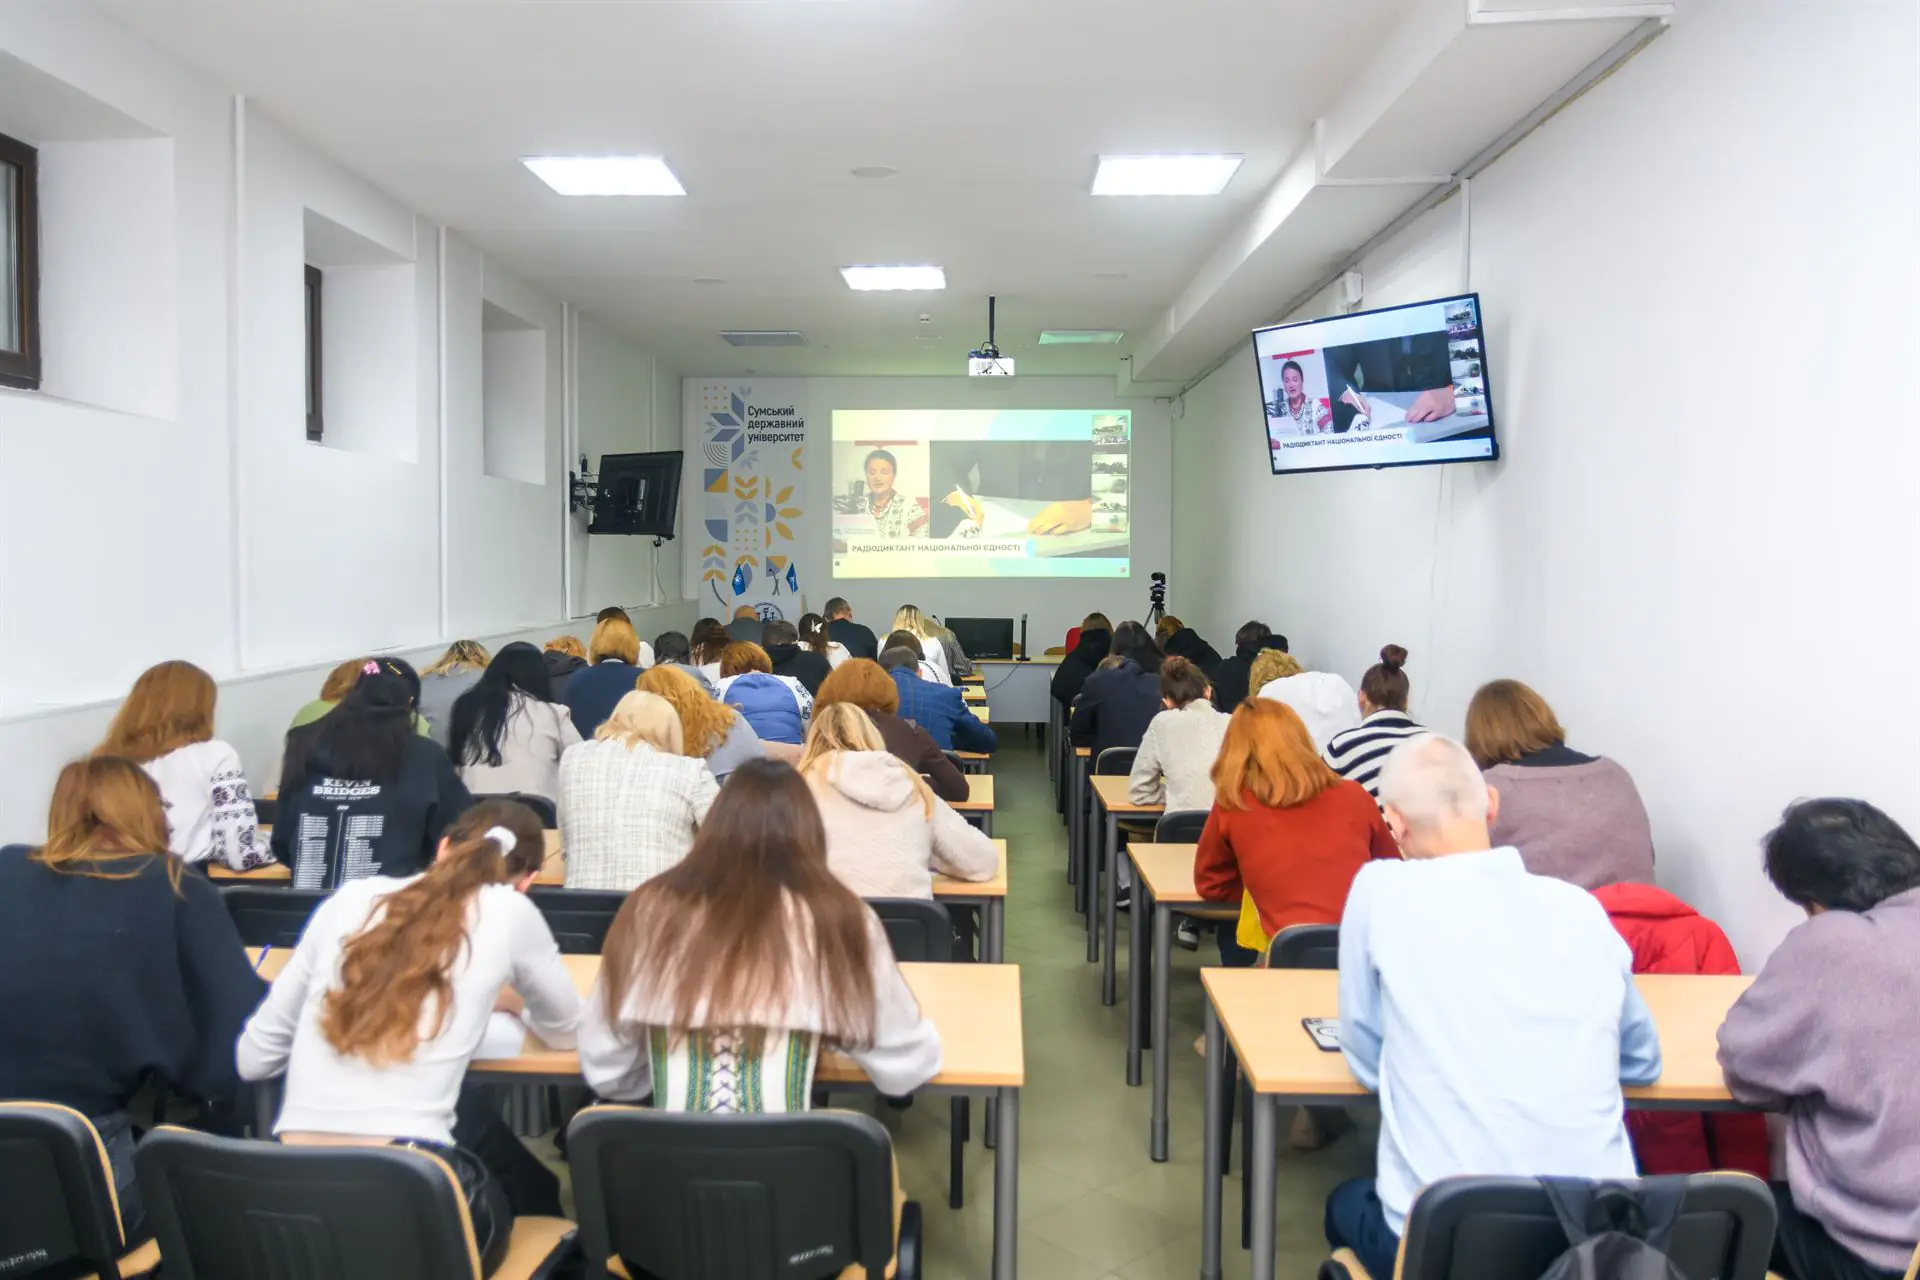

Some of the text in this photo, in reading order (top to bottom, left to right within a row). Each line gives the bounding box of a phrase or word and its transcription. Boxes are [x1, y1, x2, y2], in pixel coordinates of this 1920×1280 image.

[748, 405, 794, 418] Сумський
[748, 417, 804, 430] державний
[748, 431, 804, 444] університет
[852, 545, 915, 553] РАДІОДИКТАНТ
[983, 544, 1021, 552] ЄДНОСТІ
[323, 778, 371, 787] KEVIN
[313, 786, 380, 796] BRIDGES
